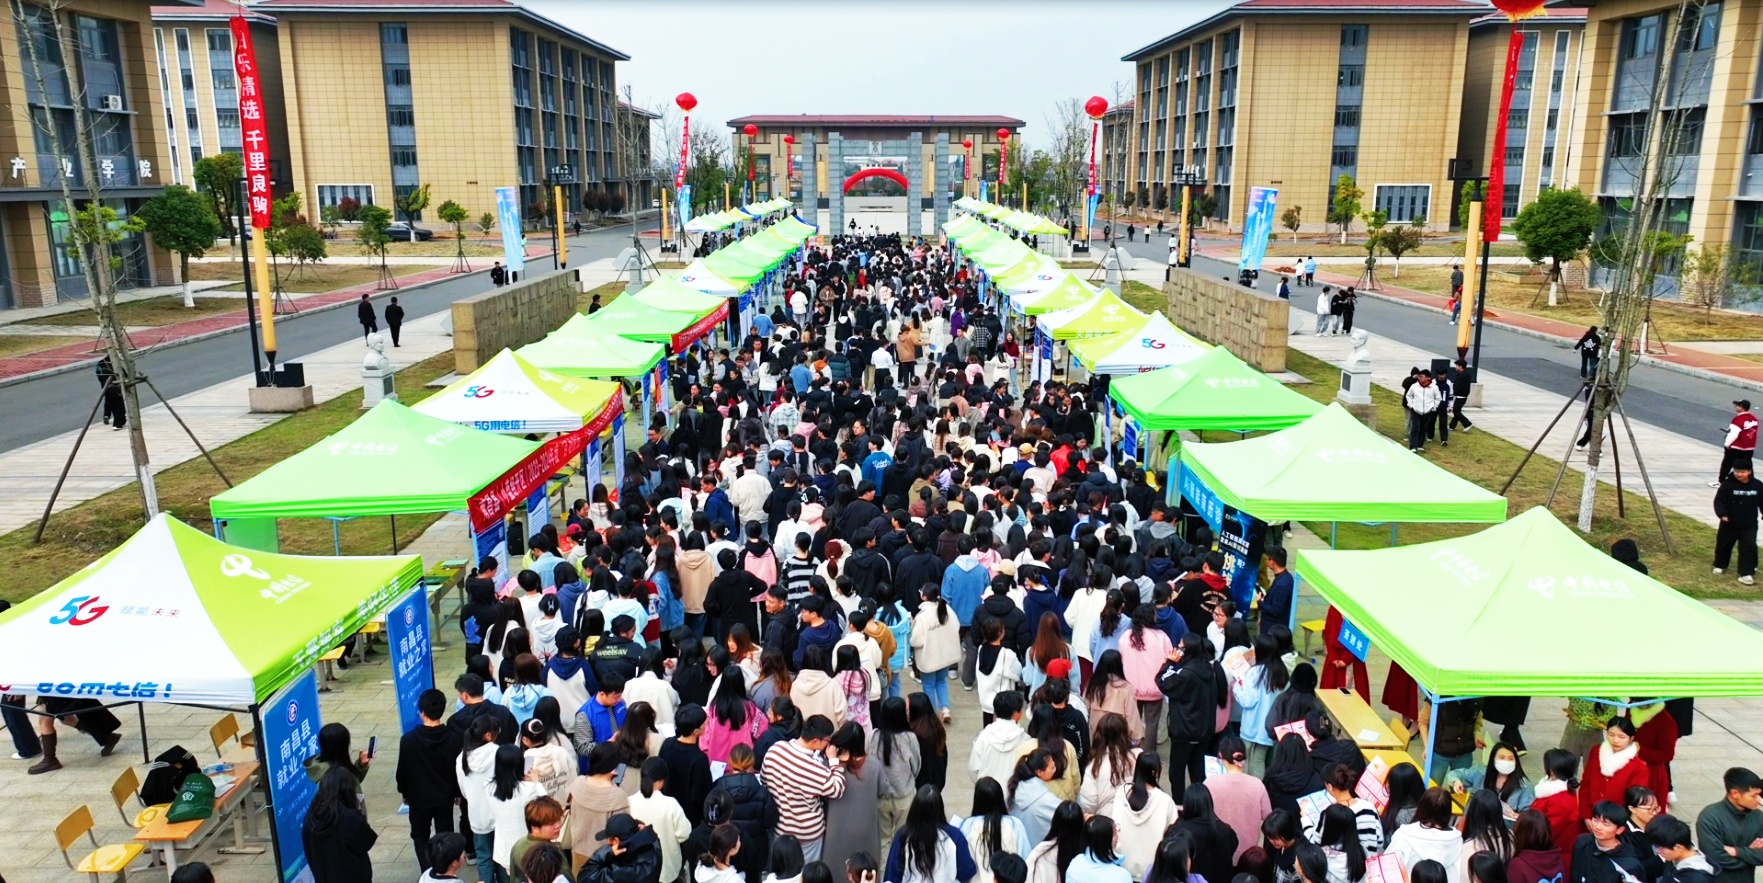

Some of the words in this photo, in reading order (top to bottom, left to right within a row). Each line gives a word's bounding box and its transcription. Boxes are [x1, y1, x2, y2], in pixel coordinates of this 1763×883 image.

[246, 129, 267, 214] 千里良驹
[1142, 338, 1165, 349] 5G
[464, 385, 494, 398] 5G
[49, 595, 109, 626] 5G
[400, 624, 423, 656] 南昌县
[280, 718, 311, 763] 南昌县
